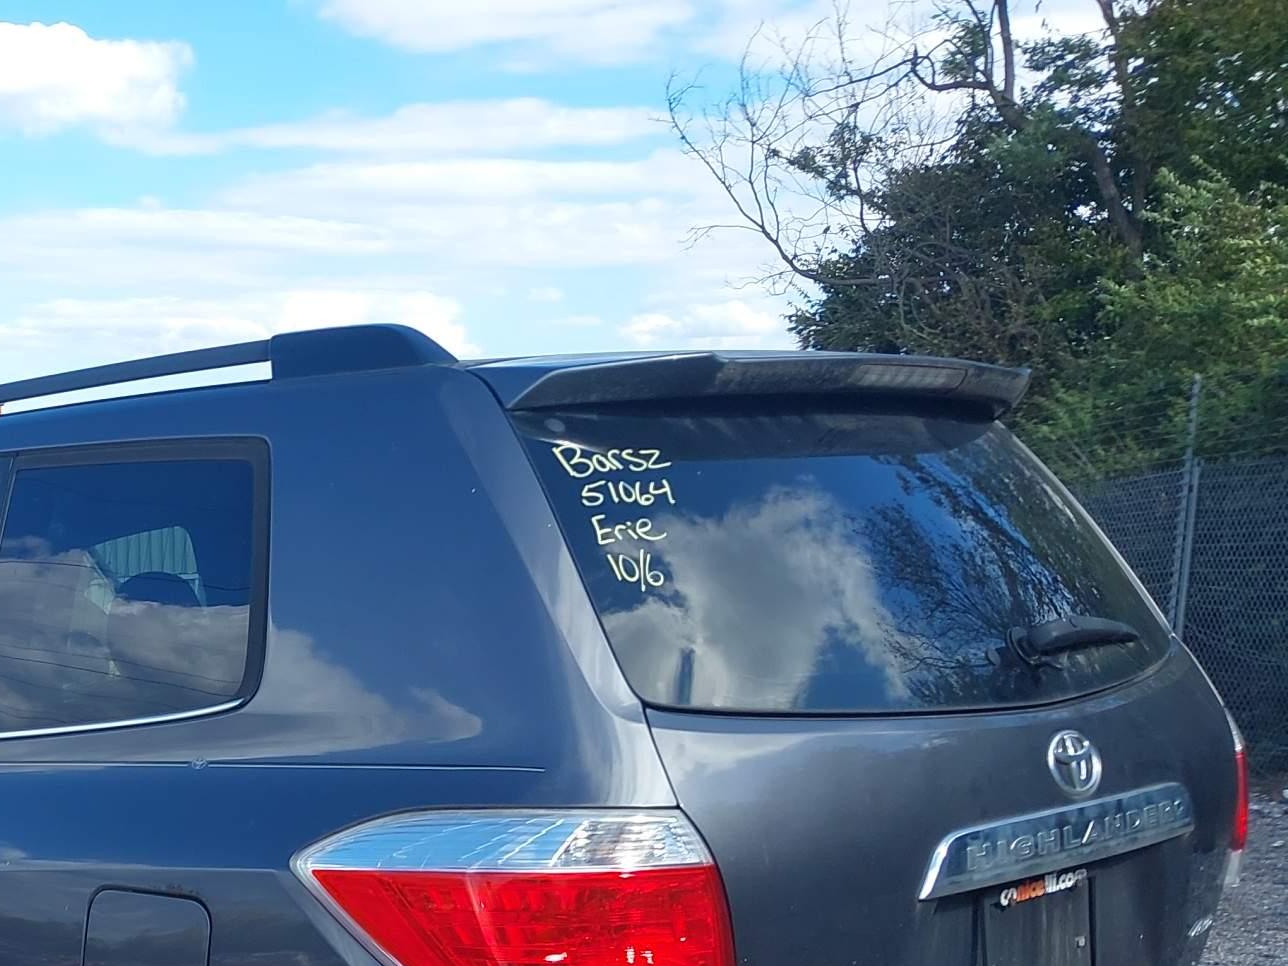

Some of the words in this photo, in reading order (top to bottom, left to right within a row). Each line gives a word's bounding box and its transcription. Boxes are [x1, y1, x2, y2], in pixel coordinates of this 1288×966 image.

[581, 479, 676, 506] 51064
[591, 514, 667, 545] Erie
[606, 549, 664, 592] 10/6
[966, 800, 1185, 872] HIGHLANDER
